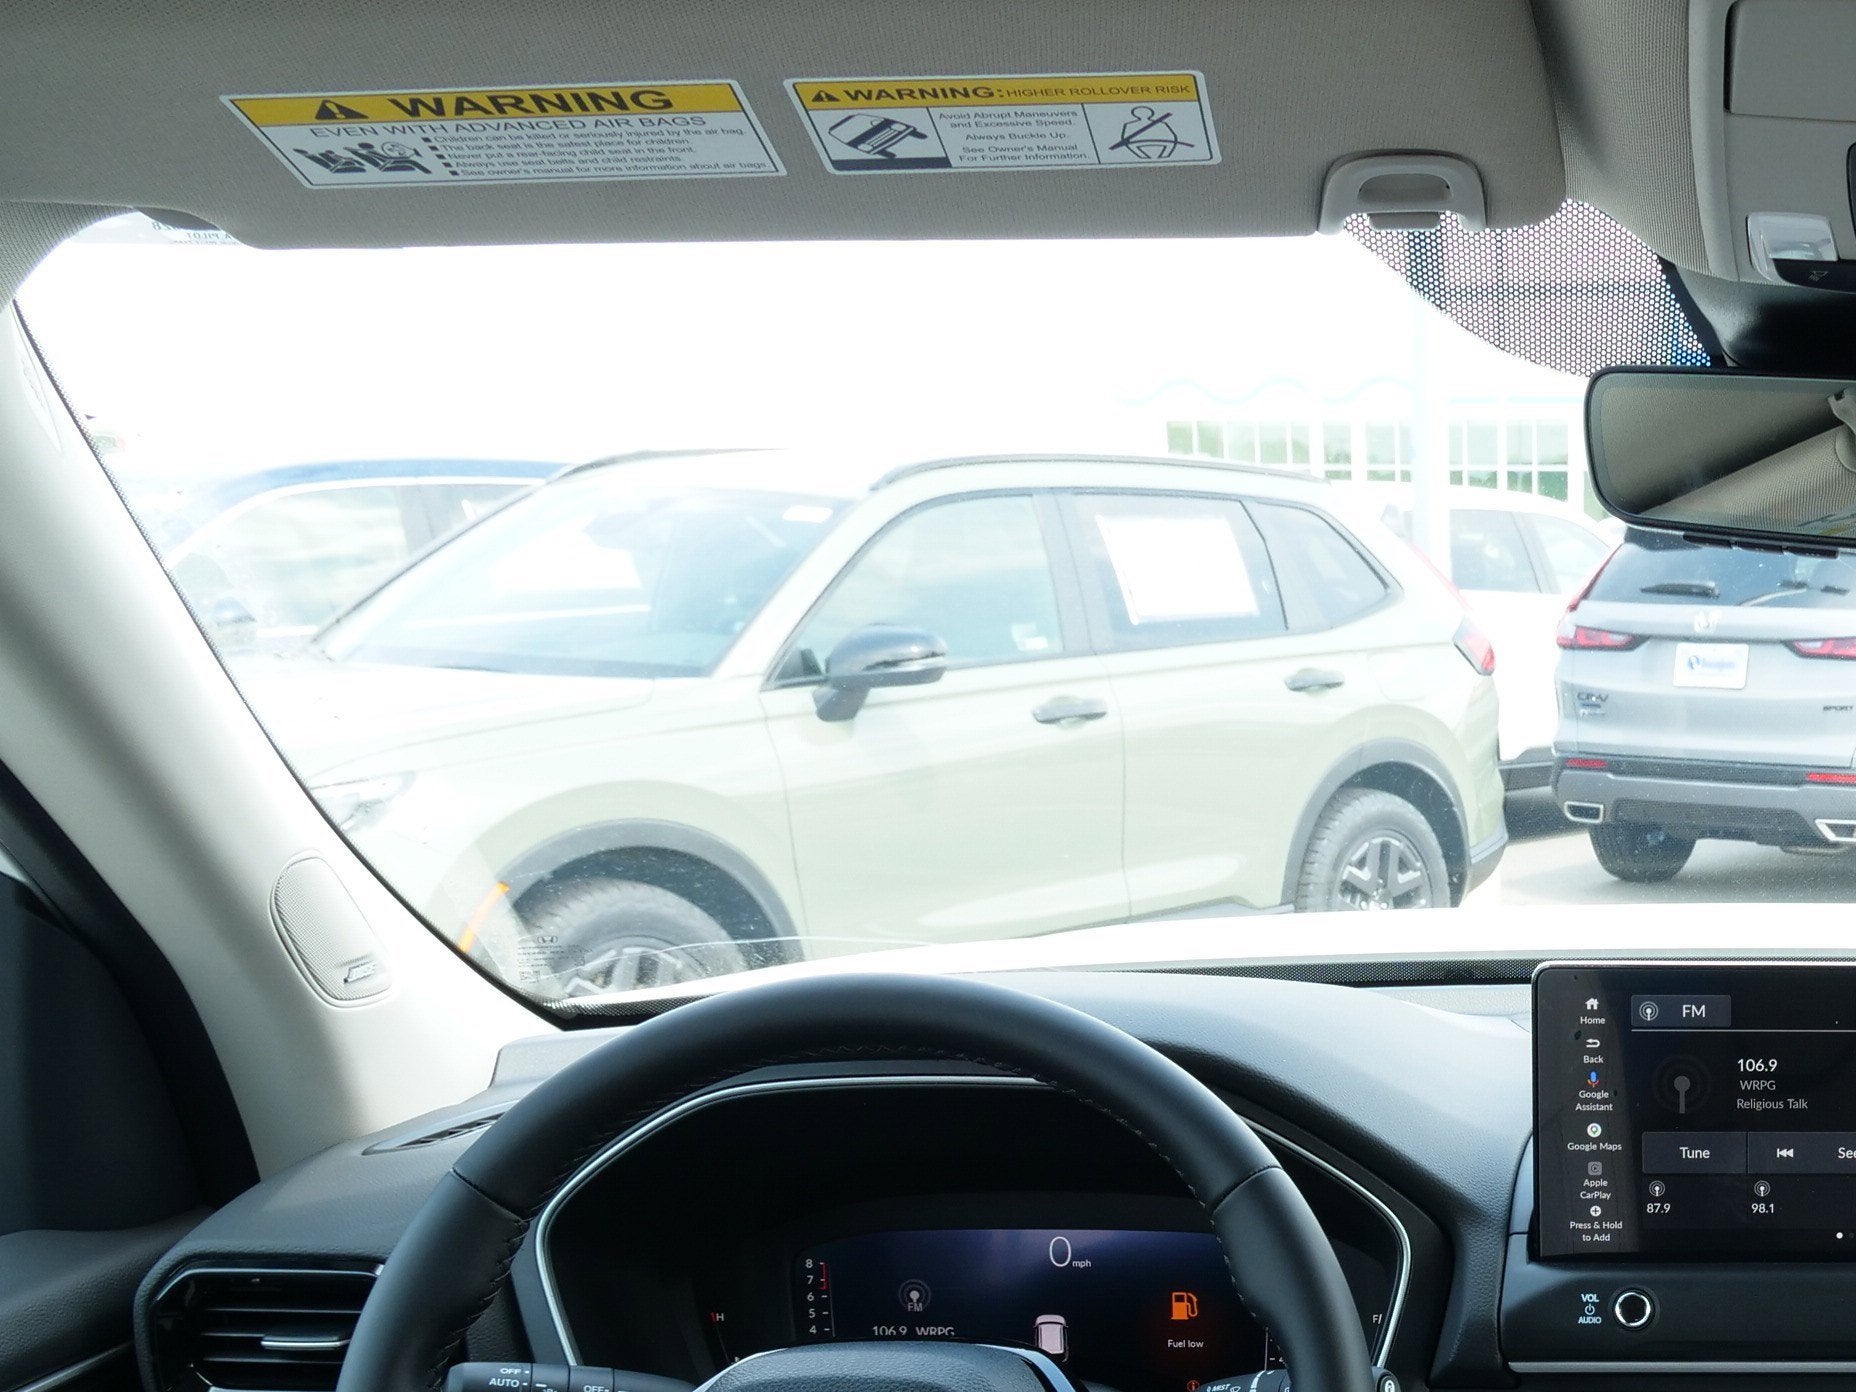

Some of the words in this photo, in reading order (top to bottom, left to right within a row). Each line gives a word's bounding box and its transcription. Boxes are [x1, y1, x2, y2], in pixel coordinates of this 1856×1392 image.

[844, 86, 1003, 101] WARNING:
[1006, 87, 1066, 98] HIGHER
[1070, 85, 1152, 96] ROLLOVER
[1157, 84, 1190, 94] RISK
[388, 89, 674, 118] WARNING
[974, 111, 1012, 120] Abrupt
[310, 125, 382, 139] EVEN
[384, 122, 448, 135] WITH
[455, 119, 587, 133] ADVANCED
[594, 118, 633, 128] AIR
[639, 116, 706, 127] BAGS
[1682, 1005, 1706, 1017] FM
[1579, 1016, 1606, 1025] Home
[1583, 1054, 1604, 1064] Back
[1737, 1059, 1778, 1071] 106.9
[1739, 1079, 1777, 1091] WRPG
[1578, 1089, 1610, 1100] Google
[1574, 1102, 1614, 1112] Assistant
[1735, 1099, 1785, 1112] Religious
[1786, 1098, 1810, 1111] Talk
[1567, 1141, 1598, 1152] Google
[1599, 1142, 1623, 1152] Maps
[1679, 1146, 1711, 1159] Tune
[1582, 1178, 1609, 1188] Apple
[1579, 1190, 1612, 1200] CarPlay
[1646, 1202, 1671, 1214] 87.9
[1751, 1202, 1774, 1214] 98.1
[1569, 1221, 1595, 1230] Press
[1592, 1221, 1601, 1230] &
[1602, 1220, 1623, 1230] Hold
[1582, 1234, 1592, 1242] to
[1592, 1233, 1611, 1242] Add
[1048, 1236, 1072, 1267] 0
[1072, 1258, 1092, 1269] mph
[805, 1258, 814, 1269] 8
[806, 1274, 814, 1285] 7
[806, 1291, 815, 1302] 6
[1580, 1293, 1600, 1303] VOL
[907, 1302, 923, 1312] FM
[808, 1308, 816, 1319] 5
[1577, 1315, 1602, 1325] AUDIO
[809, 1325, 817, 1335] 4
[872, 1325, 908, 1336] 1069
[1167, 1339, 1186, 1348] Fuel
[1187, 1339, 1204, 1348] low
[499, 1367, 522, 1375] OFF
[488, 1377, 520, 1388] AUTO
